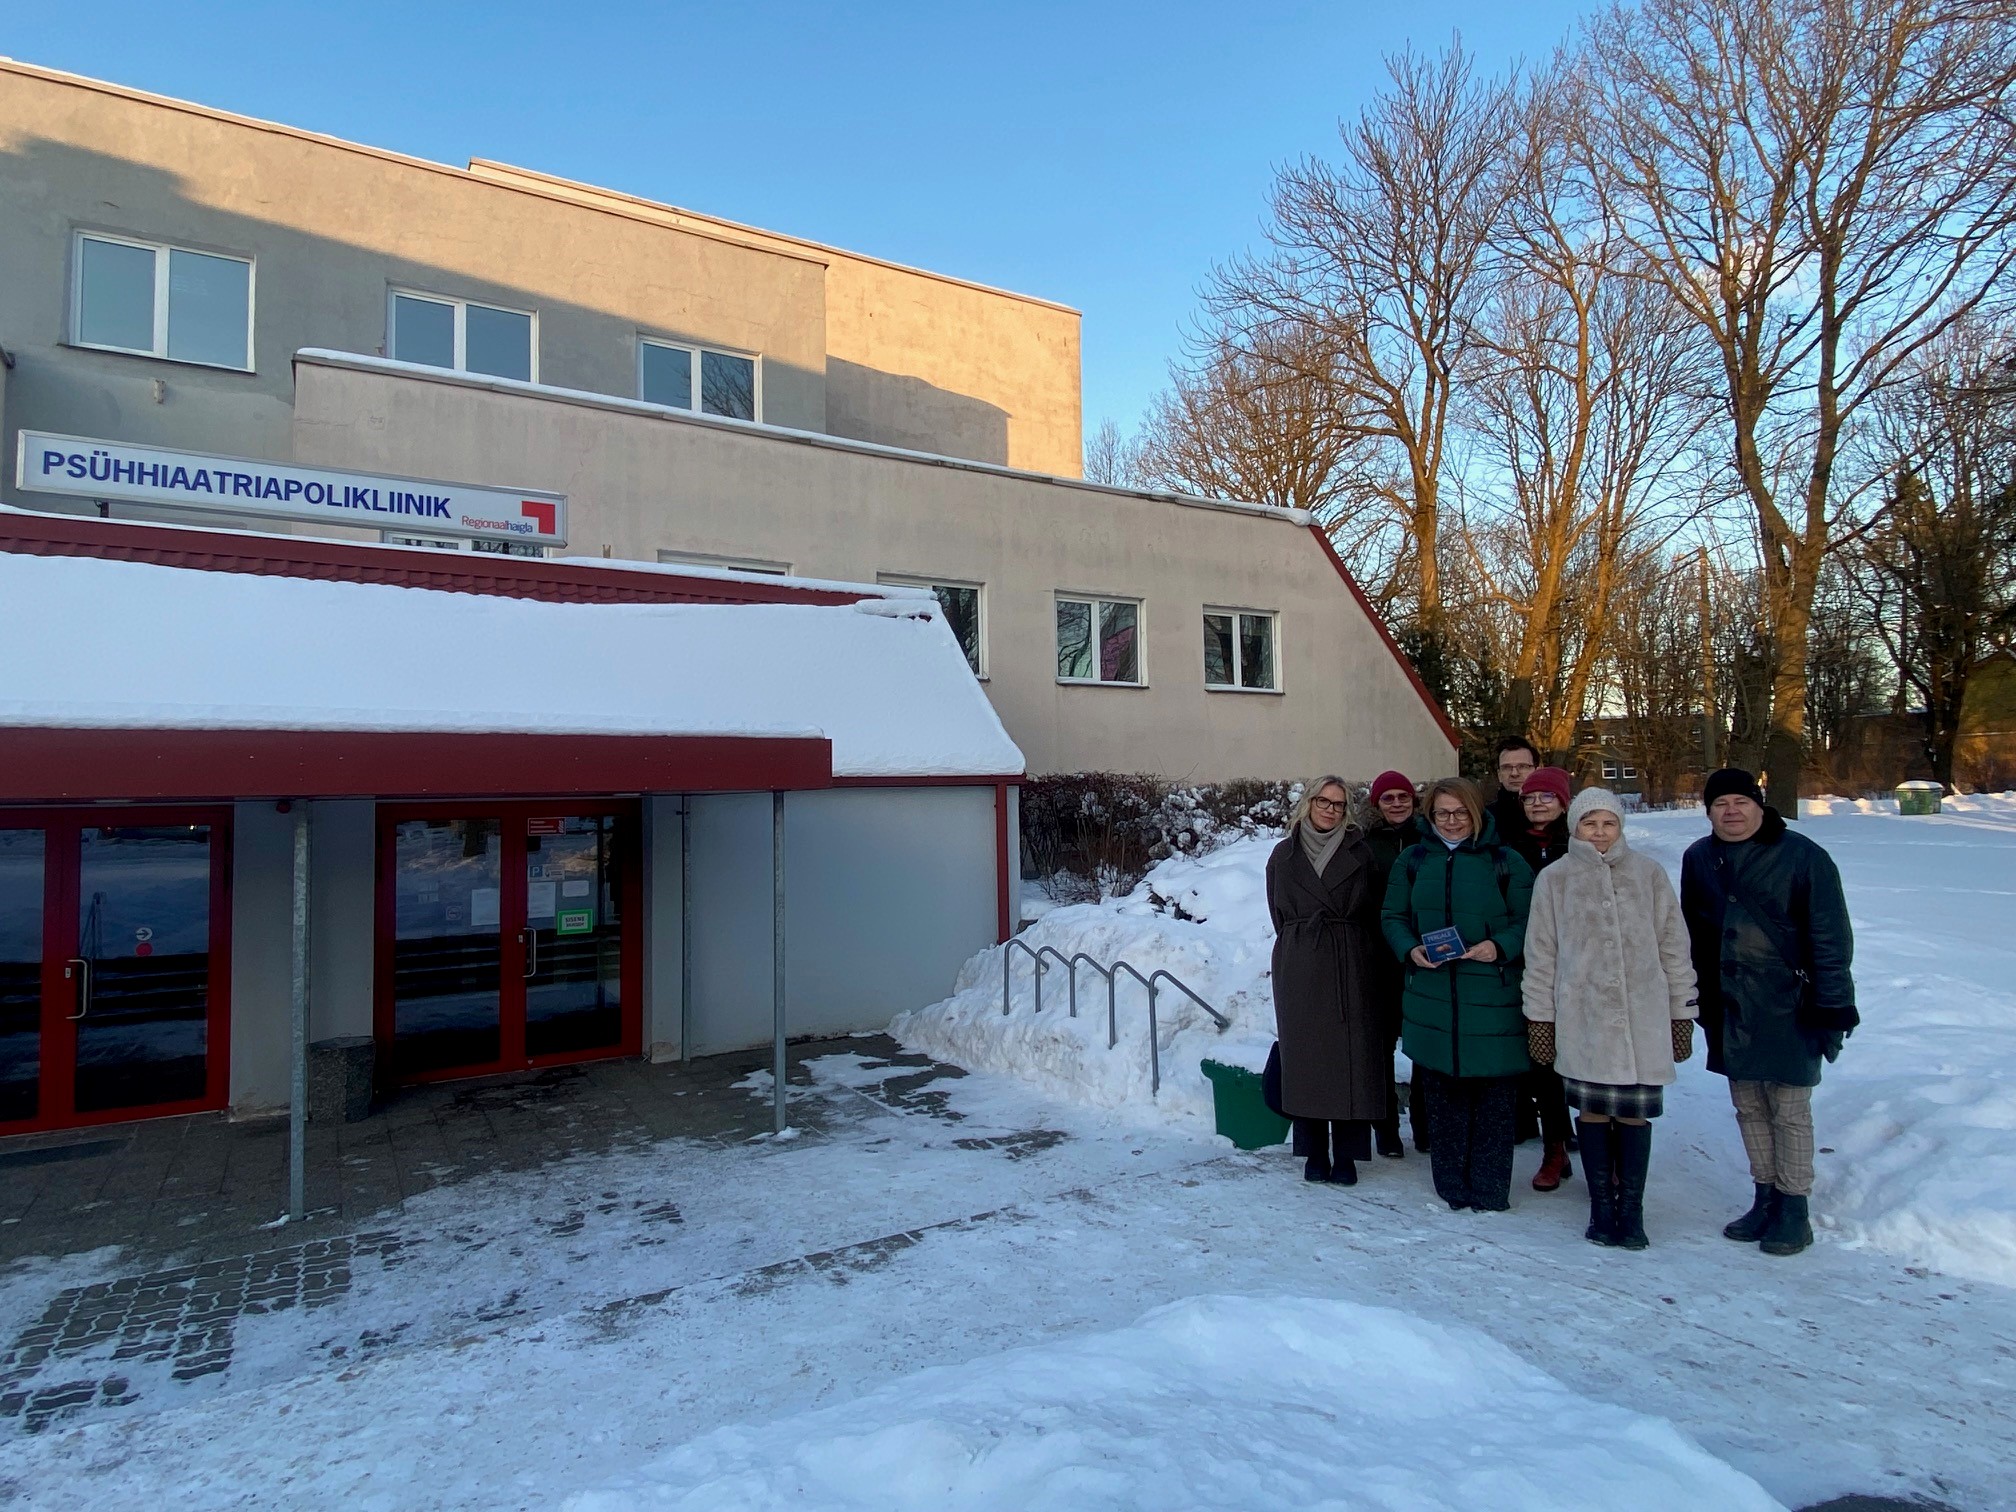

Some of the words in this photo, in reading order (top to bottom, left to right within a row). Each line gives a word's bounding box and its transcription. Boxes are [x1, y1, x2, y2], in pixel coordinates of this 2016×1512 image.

[42, 450, 452, 519] PSÜHHIAATRIAPOLIKLIINIK
[461, 515, 533, 534] Regionaalhaigla
[532, 866, 540, 877] P
